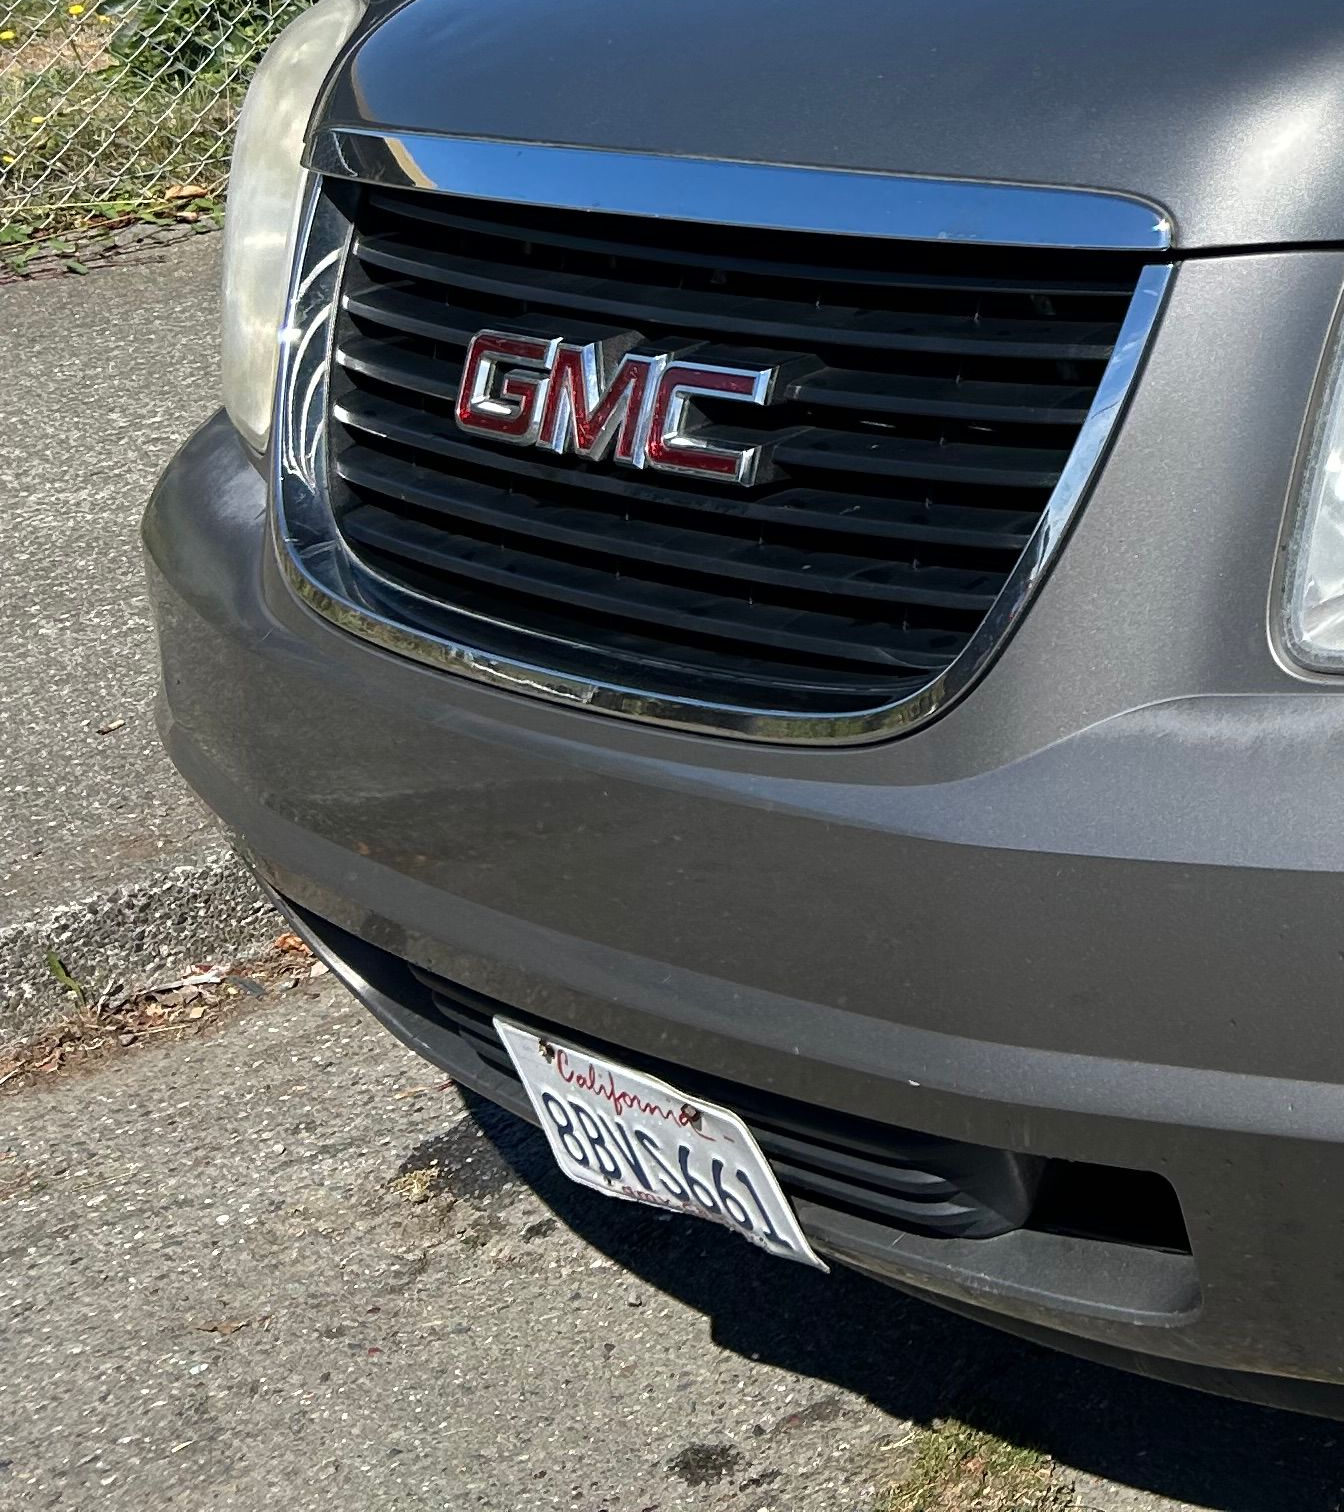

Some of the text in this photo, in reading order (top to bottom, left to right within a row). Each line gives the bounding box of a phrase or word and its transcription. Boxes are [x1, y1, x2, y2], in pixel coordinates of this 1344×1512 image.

[456, 328, 779, 487] GMC
[541, 1091, 796, 1250] 8BVS661
[557, 1049, 716, 1142] California
